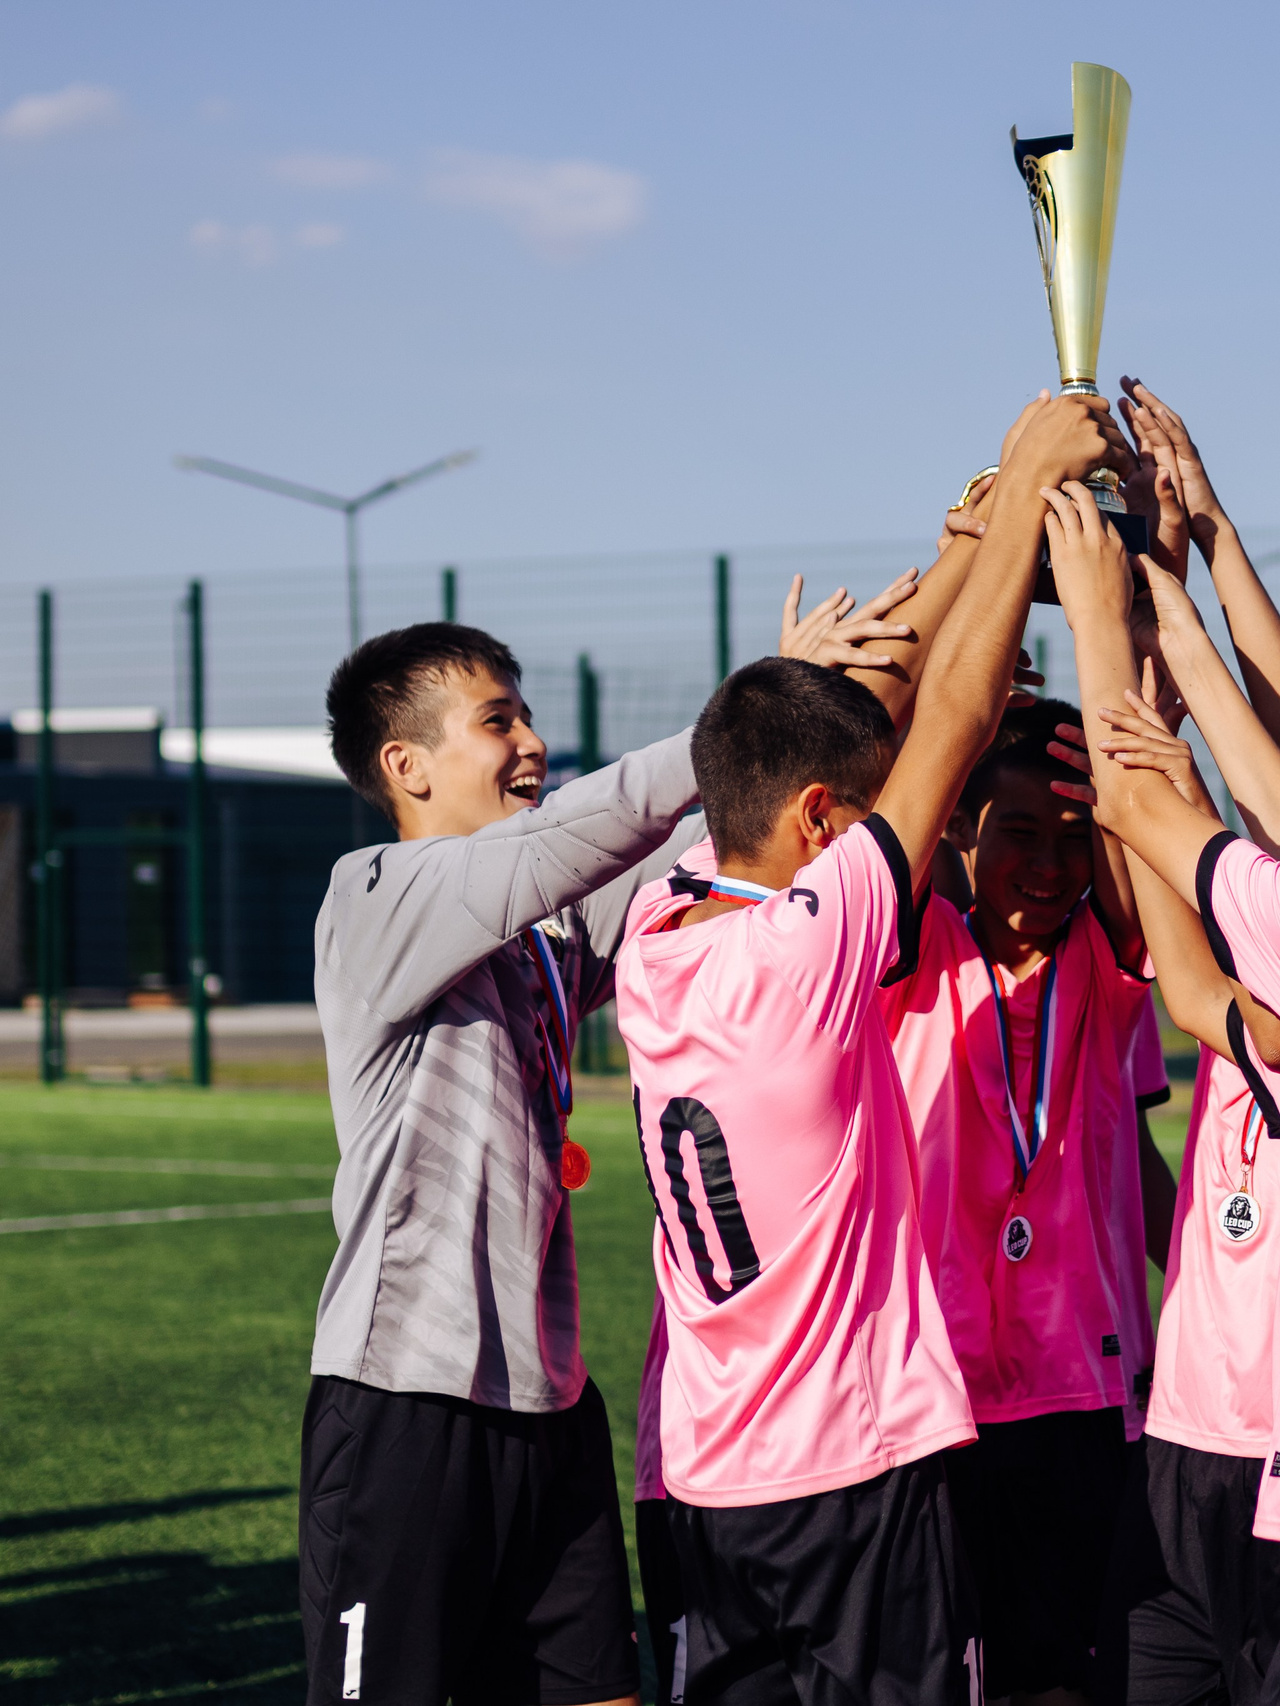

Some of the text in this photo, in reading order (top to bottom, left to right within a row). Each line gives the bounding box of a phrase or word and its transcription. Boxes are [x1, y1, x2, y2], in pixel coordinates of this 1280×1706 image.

[1225, 1216, 1252, 1230] LEO CUP
[340, 1602, 366, 1699] 1
